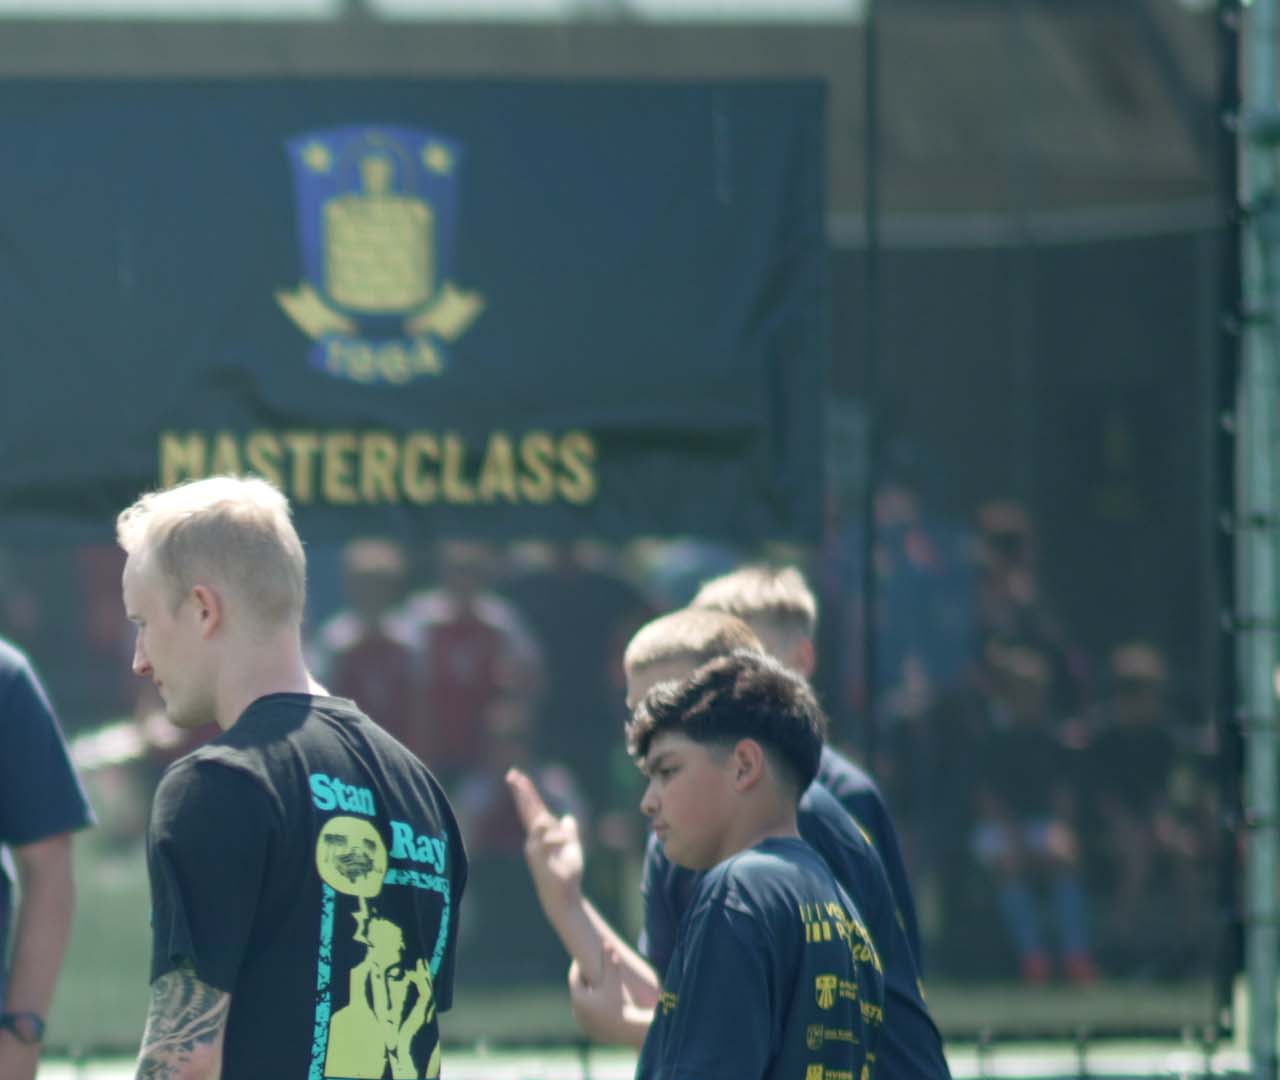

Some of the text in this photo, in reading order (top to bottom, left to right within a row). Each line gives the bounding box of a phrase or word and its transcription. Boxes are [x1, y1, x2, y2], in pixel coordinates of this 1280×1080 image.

[160, 430, 598, 506] MASTERCLASS
[309, 773, 377, 816] Stan
[389, 820, 448, 874] Ray
